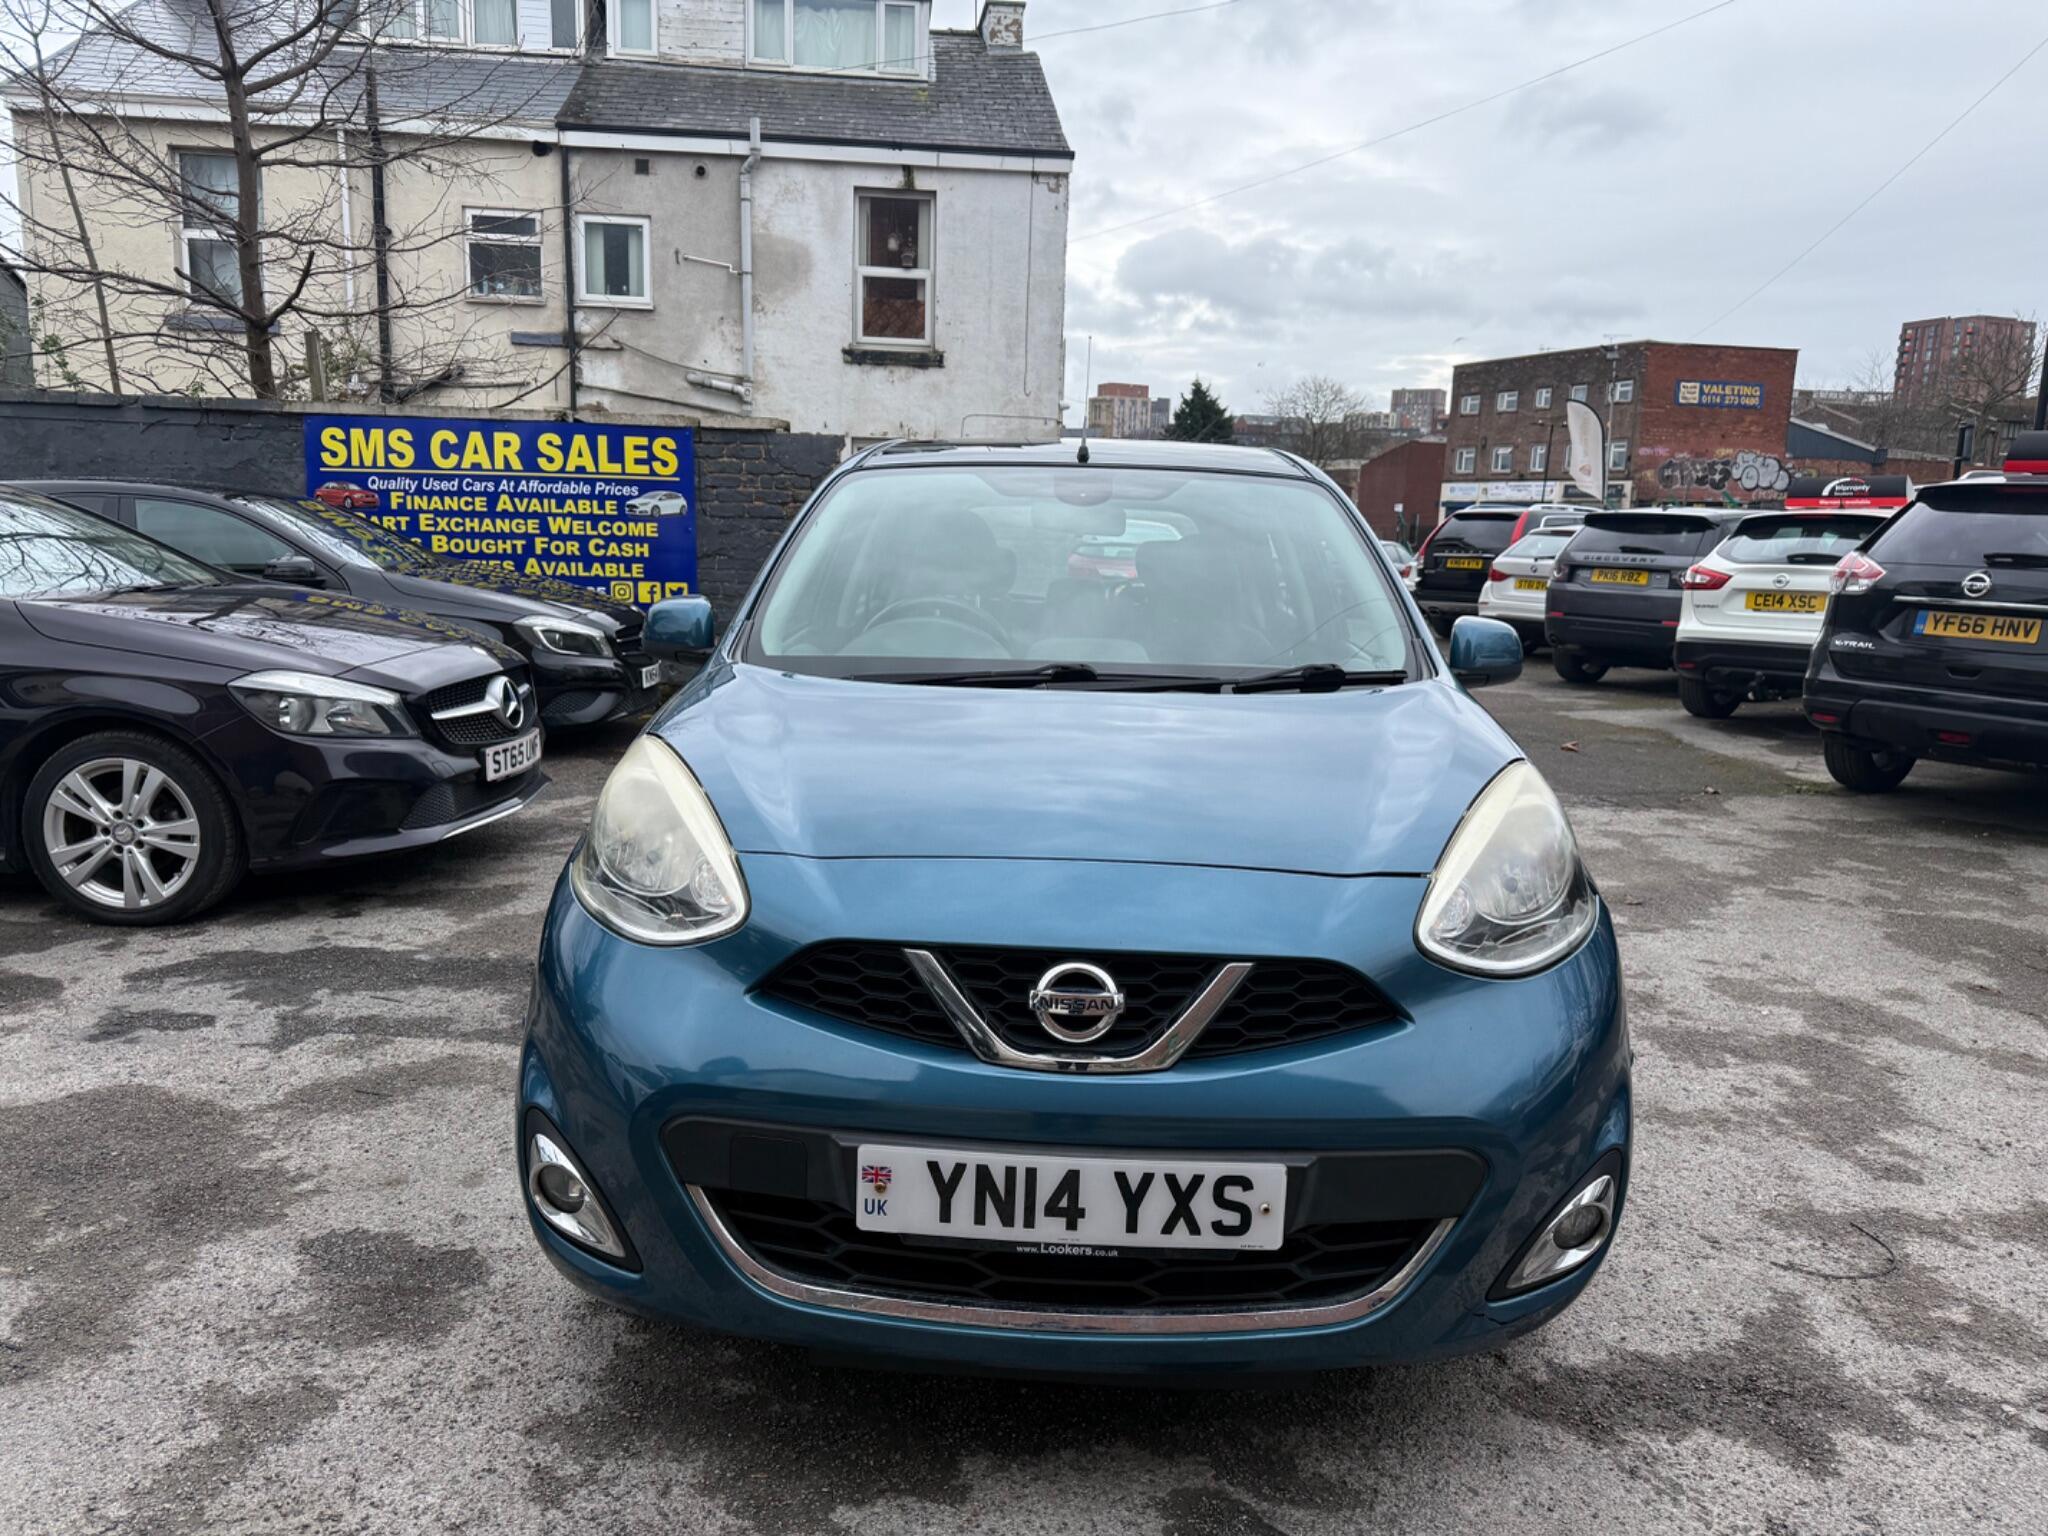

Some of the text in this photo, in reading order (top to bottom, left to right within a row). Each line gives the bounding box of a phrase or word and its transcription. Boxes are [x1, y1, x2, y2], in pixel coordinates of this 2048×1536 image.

[1703, 384, 1760, 396] VALETING
[320, 427, 679, 476] SMS CAR SALES
[368, 476, 639, 496] Quality Used Cars At Affordable Prices
[390, 492, 618, 515] FINANCE AVAILABLE
[418, 513, 540, 534] EXCHANGE
[548, 516, 659, 537] WELCOME
[431, 534, 526, 554] BOUGHT
[535, 537, 581, 556] FOR
[588, 538, 649, 557] CASH
[524, 557, 645, 578] AVAILABLE
[1584, 555, 1657, 563] DISCOVERY
[1753, 593, 1817, 609] CE14 XSC
[1932, 613, 2037, 639] YF66 HNV
[492, 742, 524, 774] ST65
[1040, 996, 1115, 1011] NISSAN
[864, 1198, 888, 1216] UK
[926, 1160, 1254, 1237] YN14 YXS
[1016, 1242, 1119, 1257] www.Lookers.co.uk
